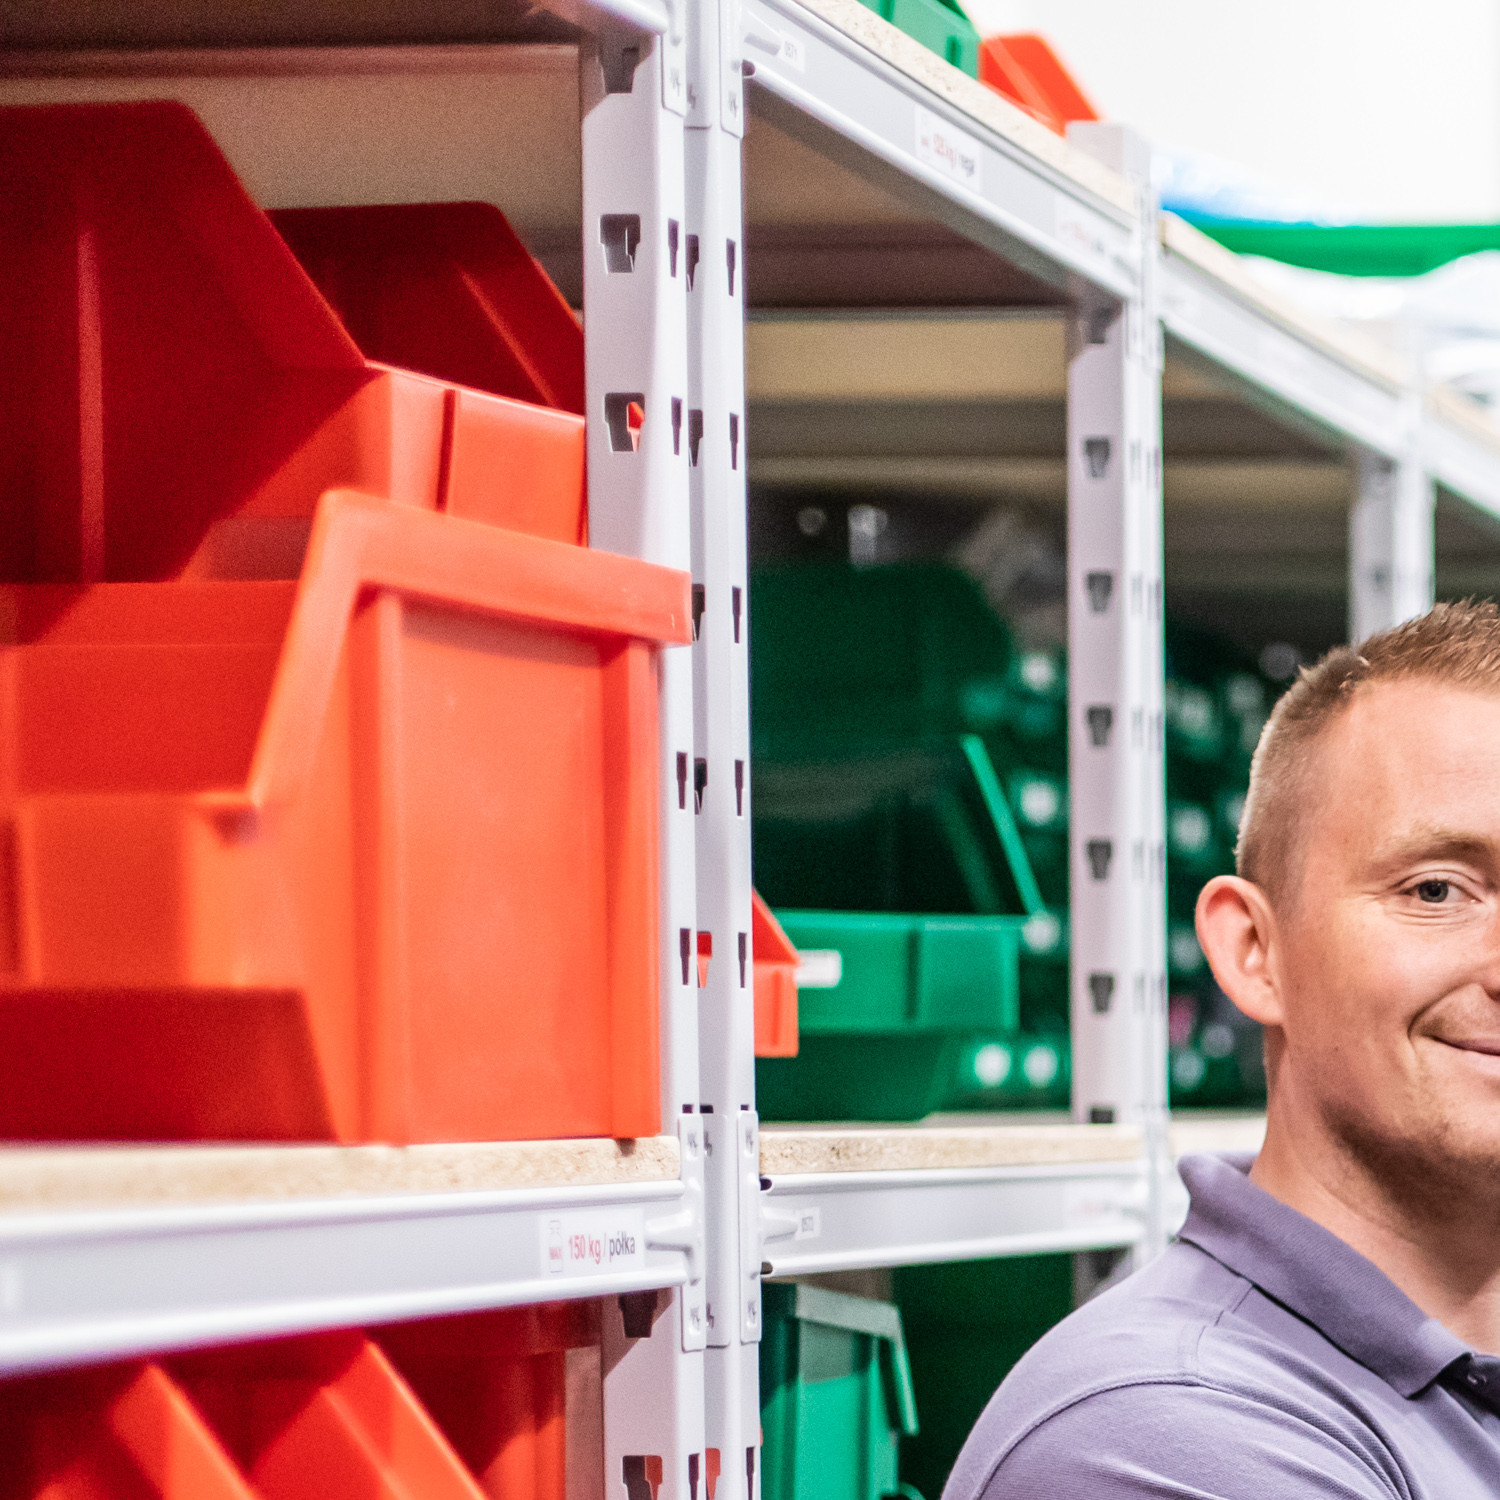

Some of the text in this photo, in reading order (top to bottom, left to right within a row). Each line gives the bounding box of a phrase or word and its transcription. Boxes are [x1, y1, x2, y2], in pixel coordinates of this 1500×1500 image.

[569, 1234, 586, 1260] 150
[588, 1233, 601, 1265] kg
[609, 1231, 636, 1263] półka
